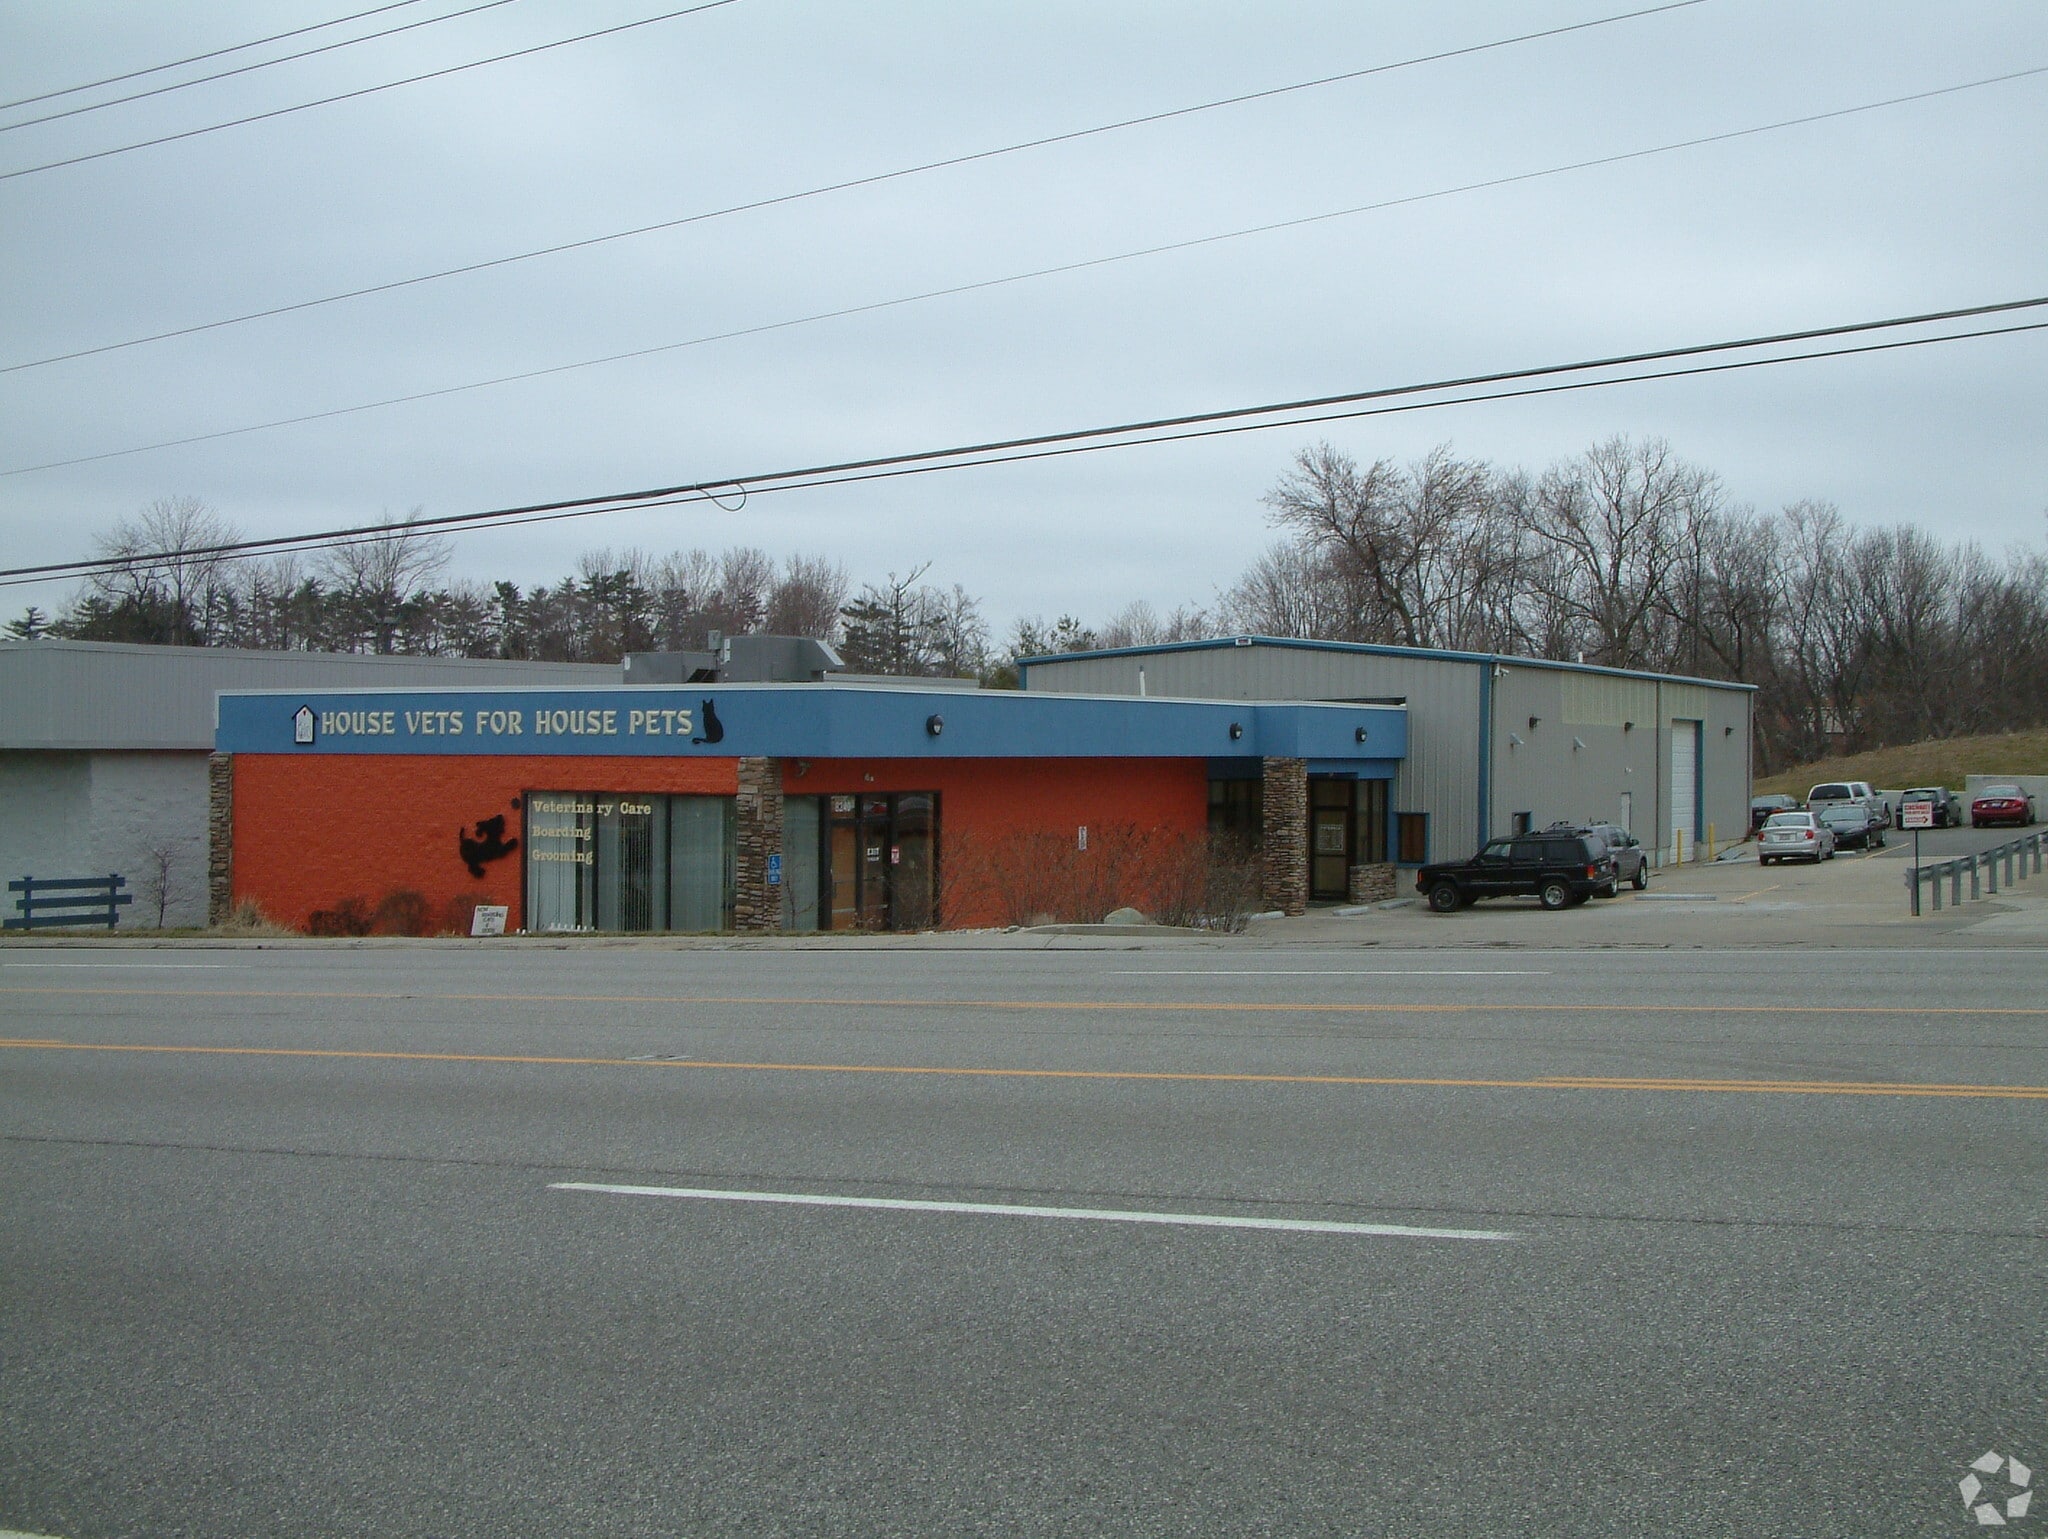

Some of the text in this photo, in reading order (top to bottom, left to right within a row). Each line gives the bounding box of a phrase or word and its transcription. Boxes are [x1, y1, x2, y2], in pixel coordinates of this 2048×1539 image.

[321, 710, 693, 735] HOUSE VETS FOR HOUSE PETS
[532, 800, 652, 817] Veterinary Care
[532, 825, 592, 841] Boarding
[532, 849, 594, 866] Grooming
